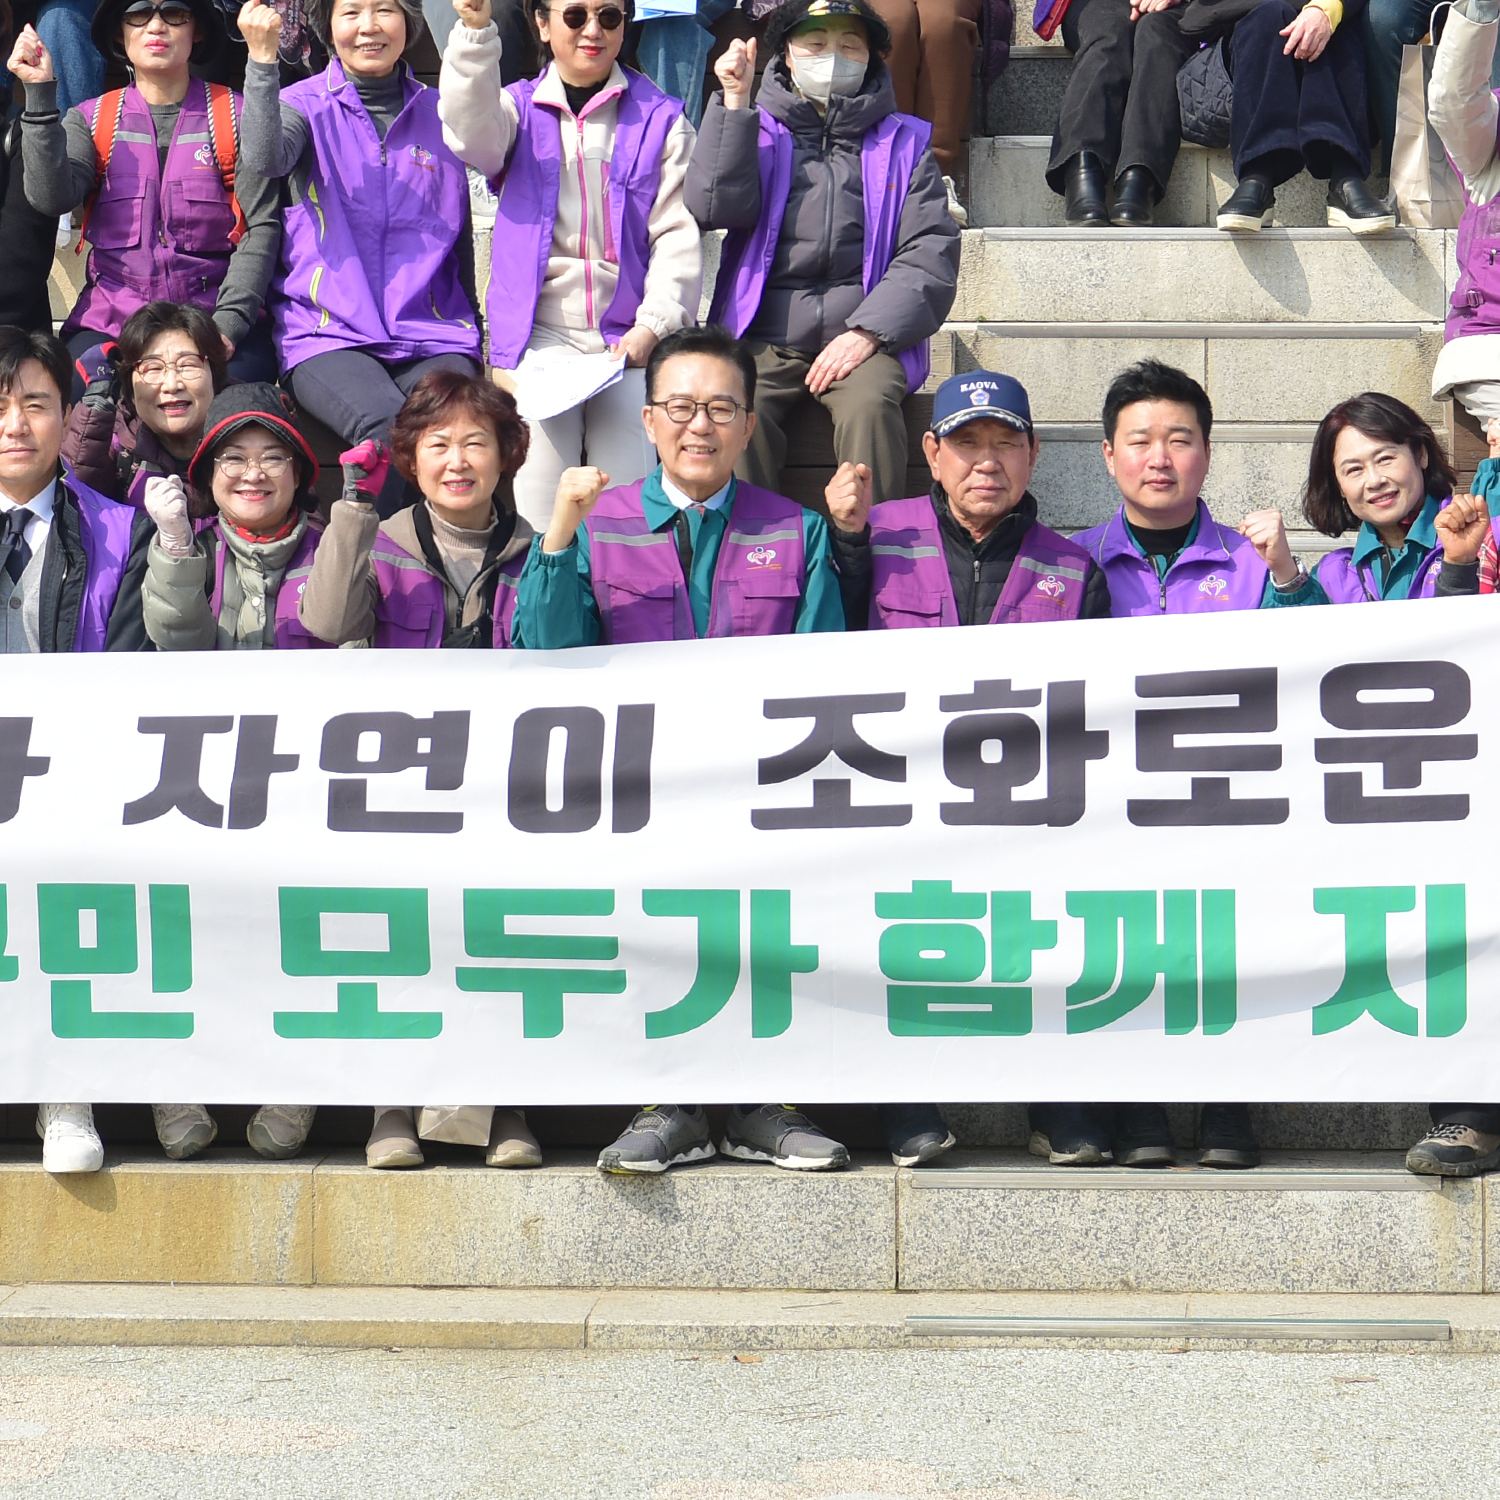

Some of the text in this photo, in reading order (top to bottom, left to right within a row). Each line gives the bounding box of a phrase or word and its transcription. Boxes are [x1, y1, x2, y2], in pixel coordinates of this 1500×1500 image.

[960, 381, 999, 393] KAOVA
[123, 703, 656, 833] 자연이
[752, 661, 1478, 829] 조화로운
[273, 886, 819, 1039] 모두가
[875, 879, 1237, 1038] 함께
